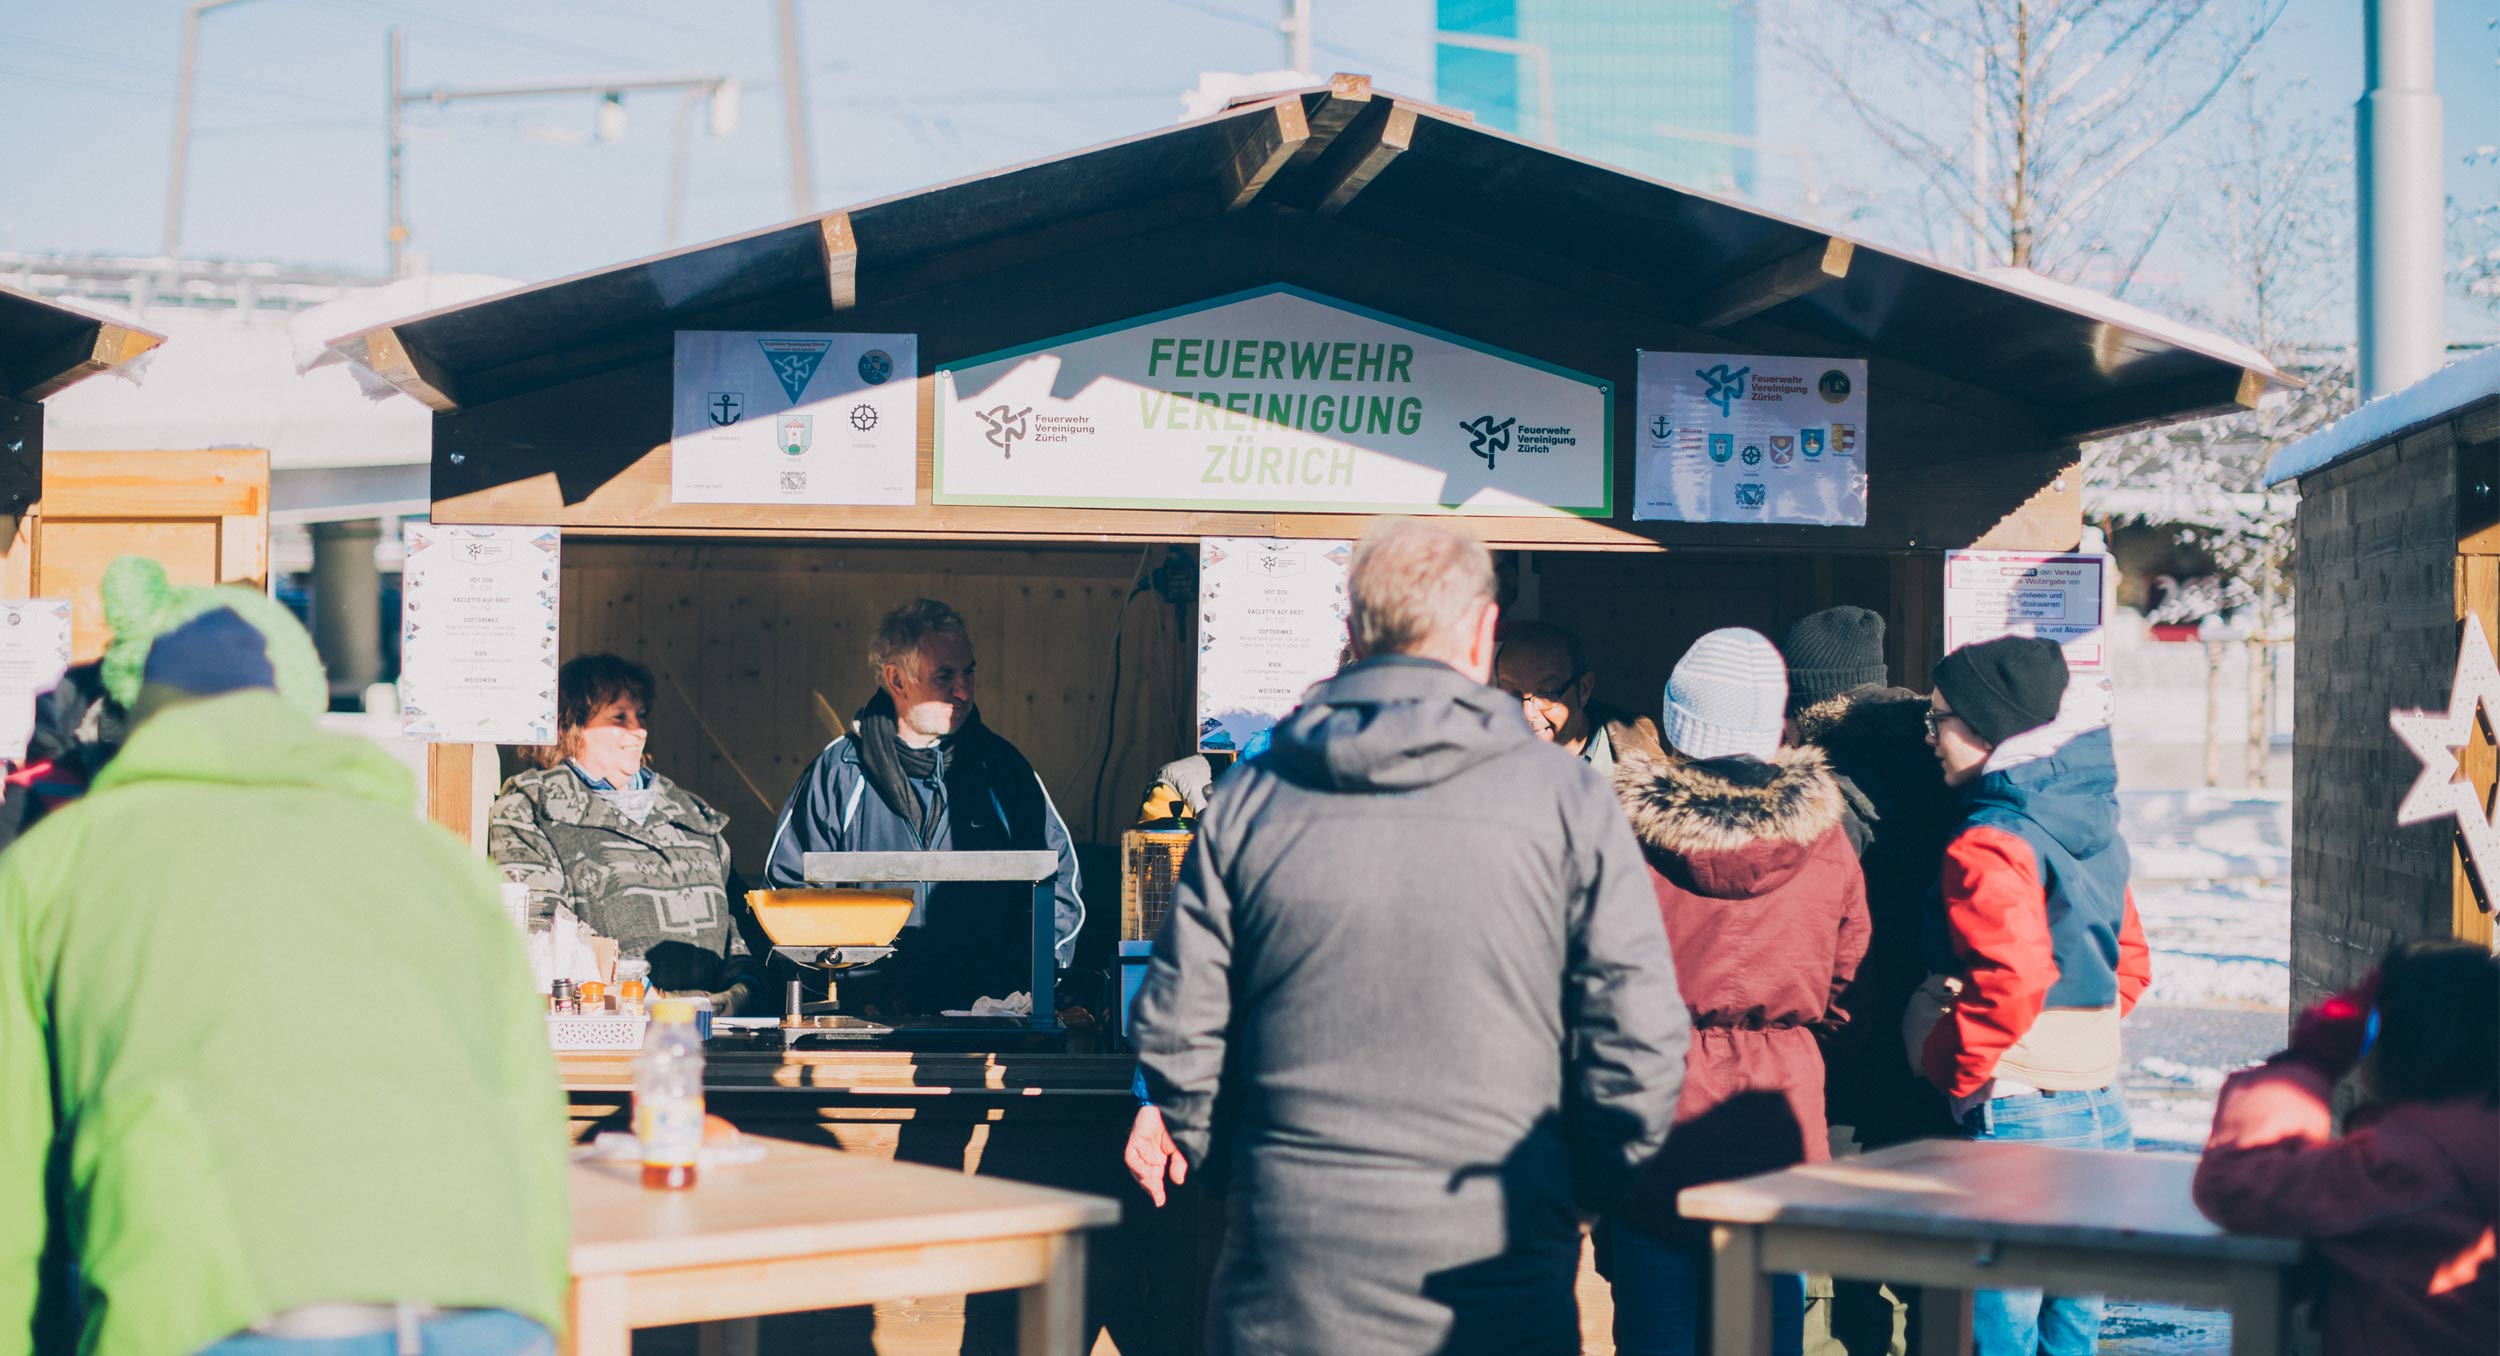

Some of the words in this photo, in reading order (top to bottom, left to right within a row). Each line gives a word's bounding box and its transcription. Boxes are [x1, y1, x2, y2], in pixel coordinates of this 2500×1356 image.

[1148, 338, 1414, 383] FEUERWEHR
[1751, 374, 1804, 384] Feuerwehr
[1751, 383, 1808, 395] Vereinigung
[1751, 392, 1783, 402] Zürich
[1140, 390, 1422, 435] VEREINIGUNG
[1035, 414, 1090, 424] Feuerwehr
[1034, 424, 1095, 435] Vereinigung
[1518, 425, 1571, 435] Feuerwehr
[1034, 433, 1068, 443] Zürich
[1517, 434, 1576, 446] Vereinigung
[1517, 444, 1550, 453] Zürich
[1201, 435, 1356, 486] ZÜRICH
[2025, 578, 2066, 586] Weitergabe
[2064, 626, 2096, 635] Alcopo
